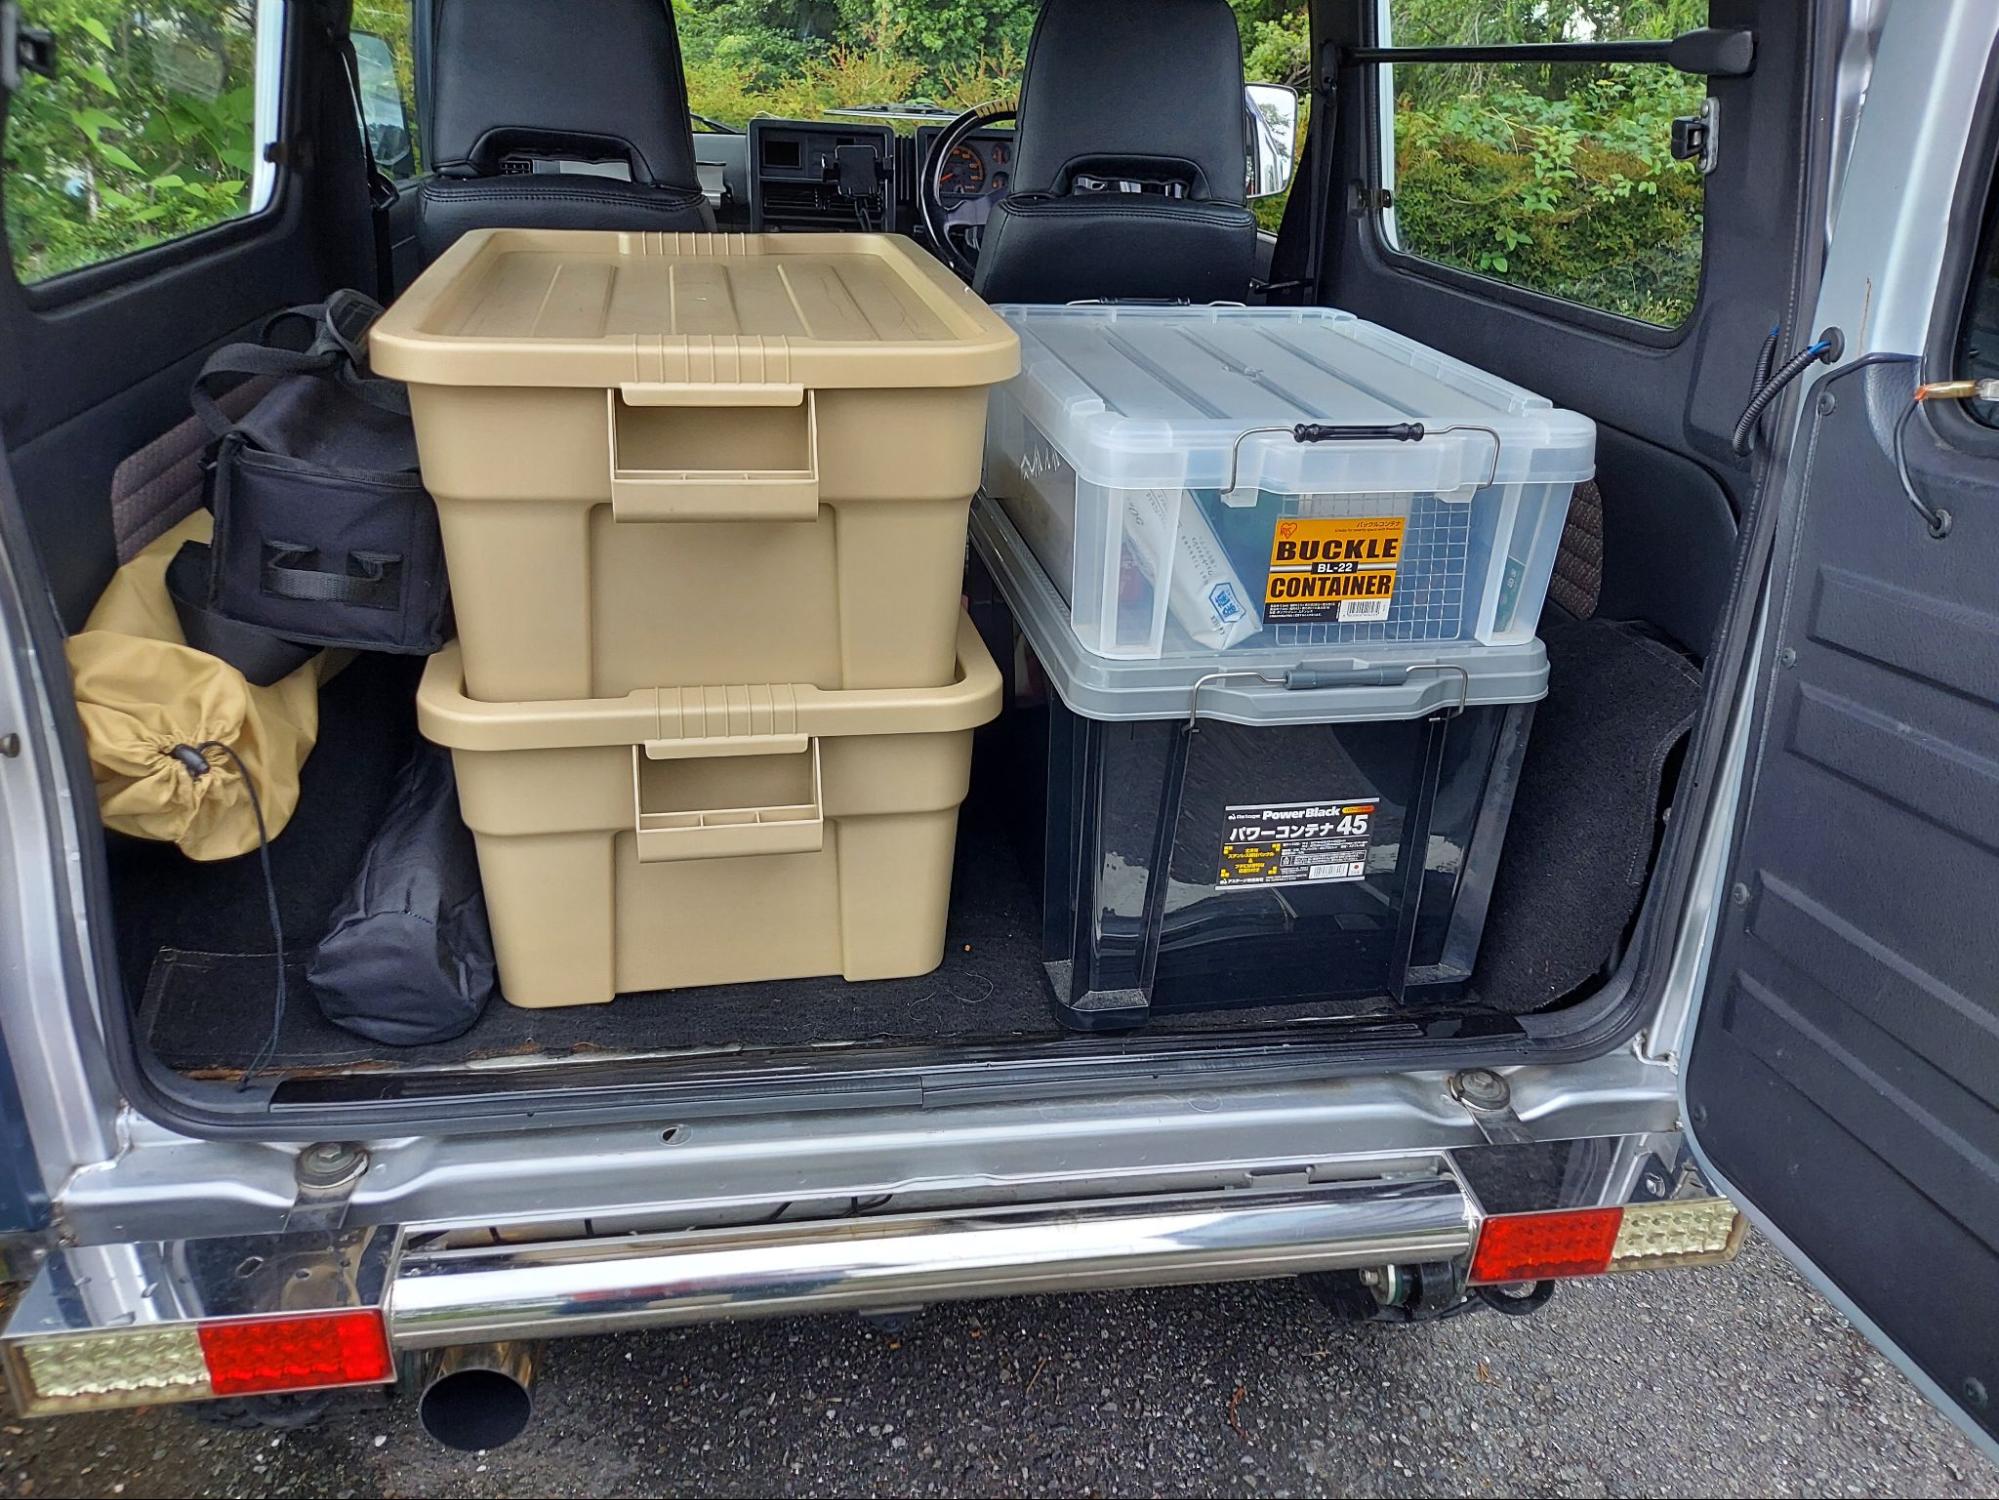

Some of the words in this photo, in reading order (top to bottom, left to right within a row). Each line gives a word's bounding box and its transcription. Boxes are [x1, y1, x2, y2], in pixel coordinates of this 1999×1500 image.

[1277, 538, 1399, 560] BUCKLE
[1318, 563, 1353, 573] BL-22
[1270, 574, 1392, 598] CONTAINER
[1229, 822, 1335, 842] パワーコンテナ
[1336, 814, 1369, 836] 45
